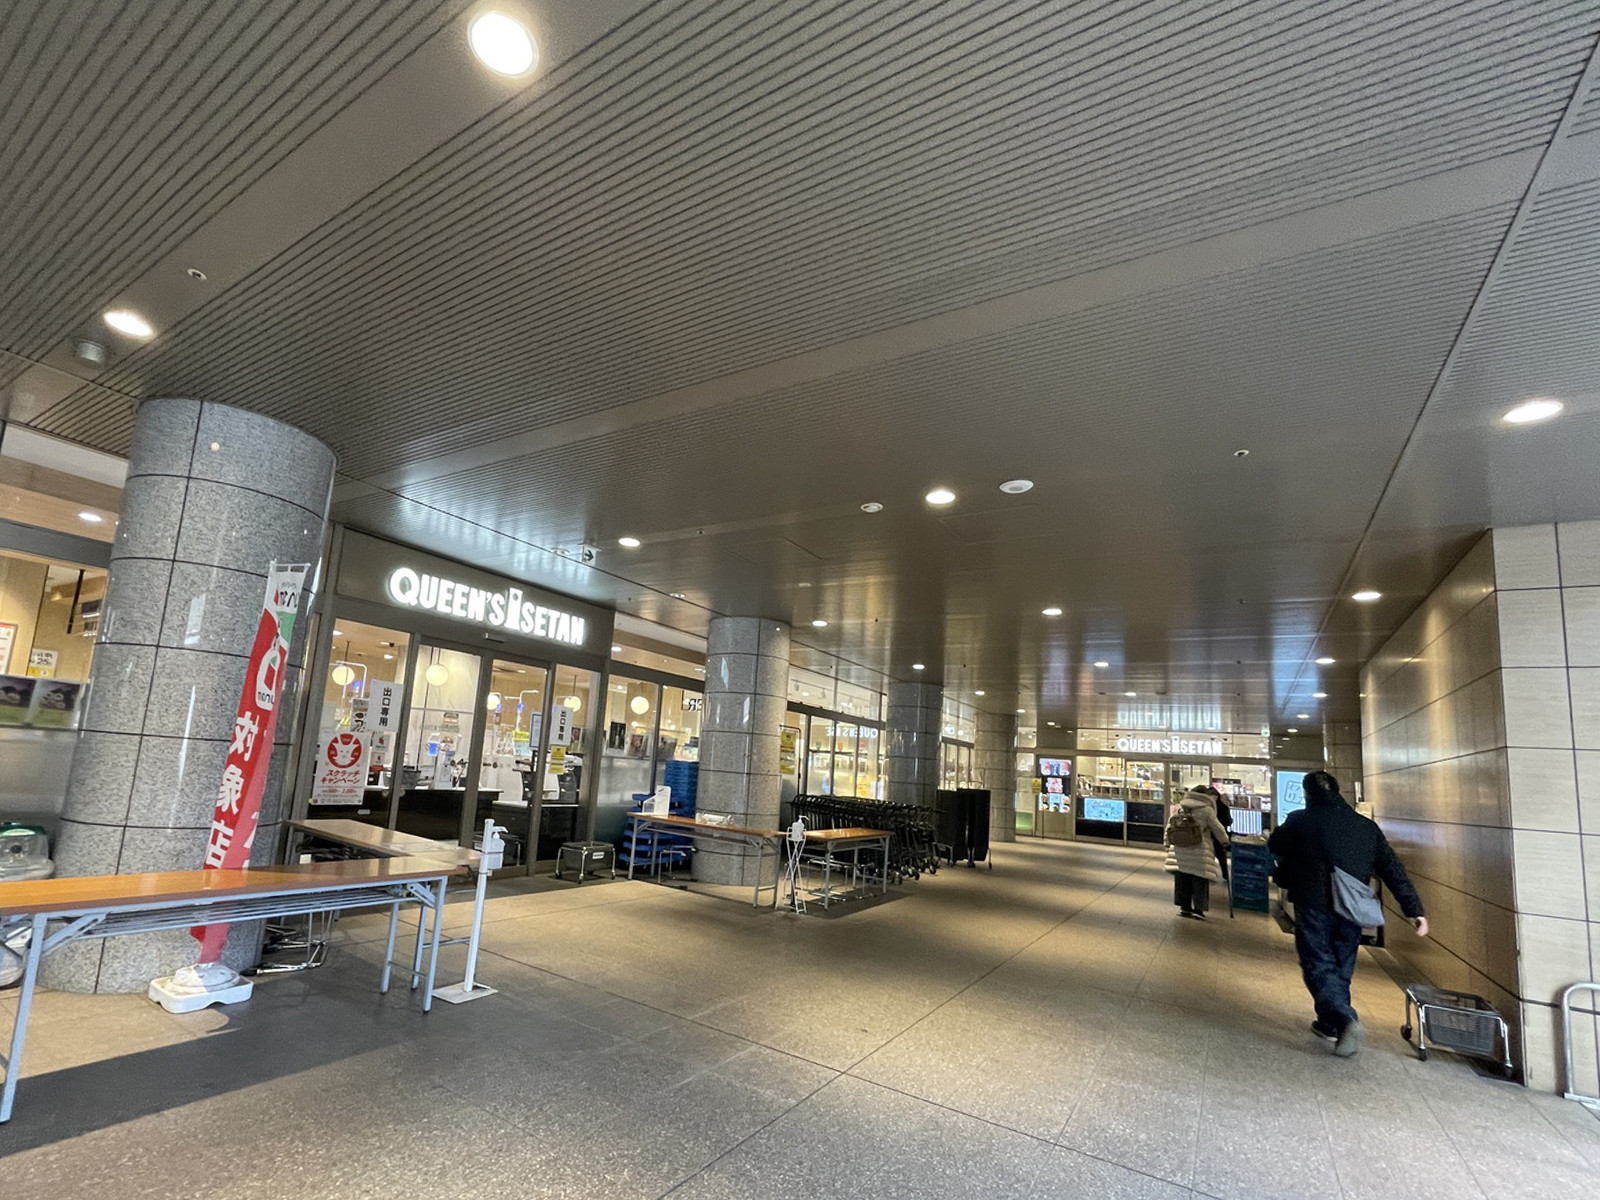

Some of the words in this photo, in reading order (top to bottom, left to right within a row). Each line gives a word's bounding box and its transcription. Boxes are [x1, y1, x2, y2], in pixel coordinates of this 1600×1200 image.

[389, 567, 505, 626] QUEEN'S
[504, 587, 585, 646] ISETAN
[379, 687, 392, 727] 出口専用
[1117, 738, 1171, 753] QUEEN'S
[205, 711, 259, 869] 対象店
